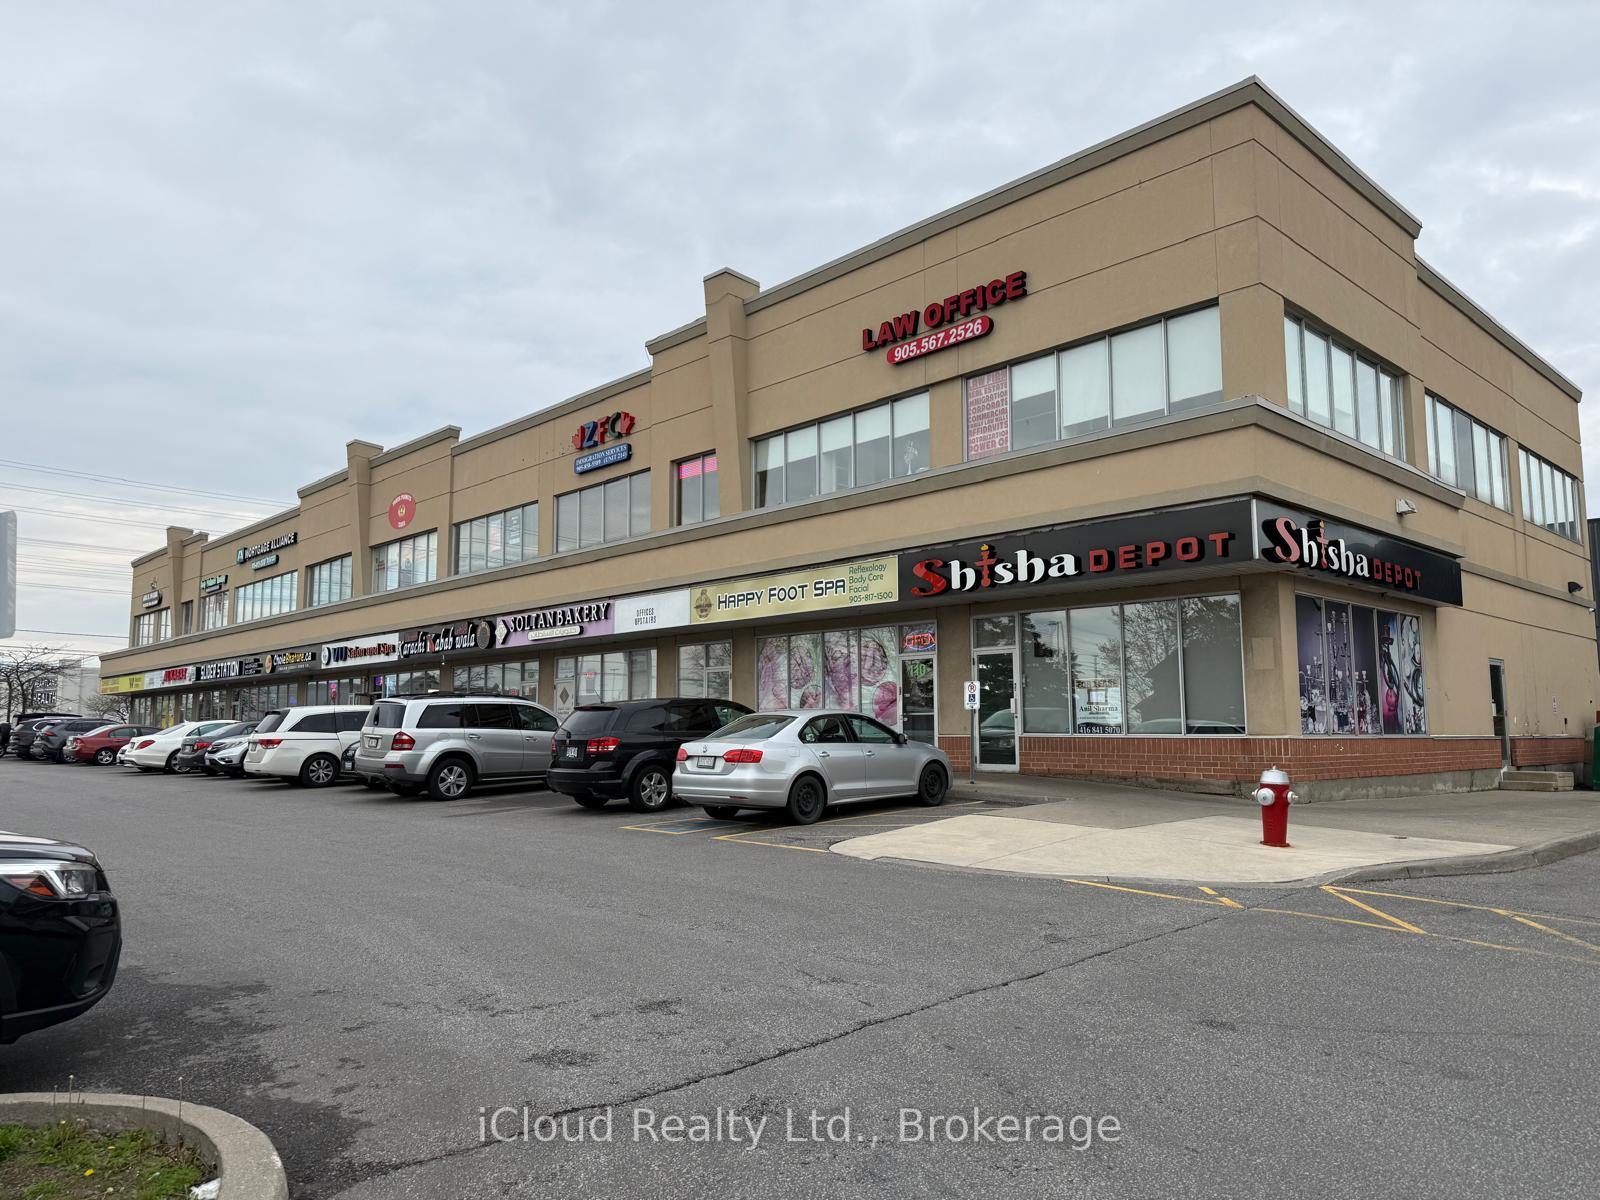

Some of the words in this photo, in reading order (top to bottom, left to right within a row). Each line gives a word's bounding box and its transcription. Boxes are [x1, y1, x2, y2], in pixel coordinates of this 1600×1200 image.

[862, 310, 919, 350] LAW
[924, 271, 1027, 328] OFFICE
[894, 319, 982, 361] 905.567.2526
[984, 382, 1008, 394] ESTATE
[245, 541, 270, 560] MORTGAGE
[270, 532, 296, 551] ALLIANCE
[1275, 517, 1370, 578] Shisha
[1373, 559, 1422, 590] DEPOT
[849, 561, 887, 576] Reflexology
[911, 544, 1079, 597] Shisha
[1089, 531, 1230, 573] DEPOT
[849, 575, 867, 585] Body
[868, 572, 884, 582] Care
[717, 590, 764, 610] HAPPY
[768, 584, 808, 604] FOOT
[814, 578, 846, 597] SPA
[849, 584, 869, 594] Facial
[849, 592, 893, 604] 905-817-1500
[636, 607, 654, 617] OFFICES
[635, 615, 656, 626] UPSTAIRS
[397, 632, 425, 658] Karachi
[426, 625, 454, 653] Kabab
[905, 632, 937, 646] OPEN
[200, 663, 217, 680] SLIDER
[217, 661, 239, 678] STATION
[1080, 726, 1091, 734] 416
[1092, 726, 1103, 734] 841
